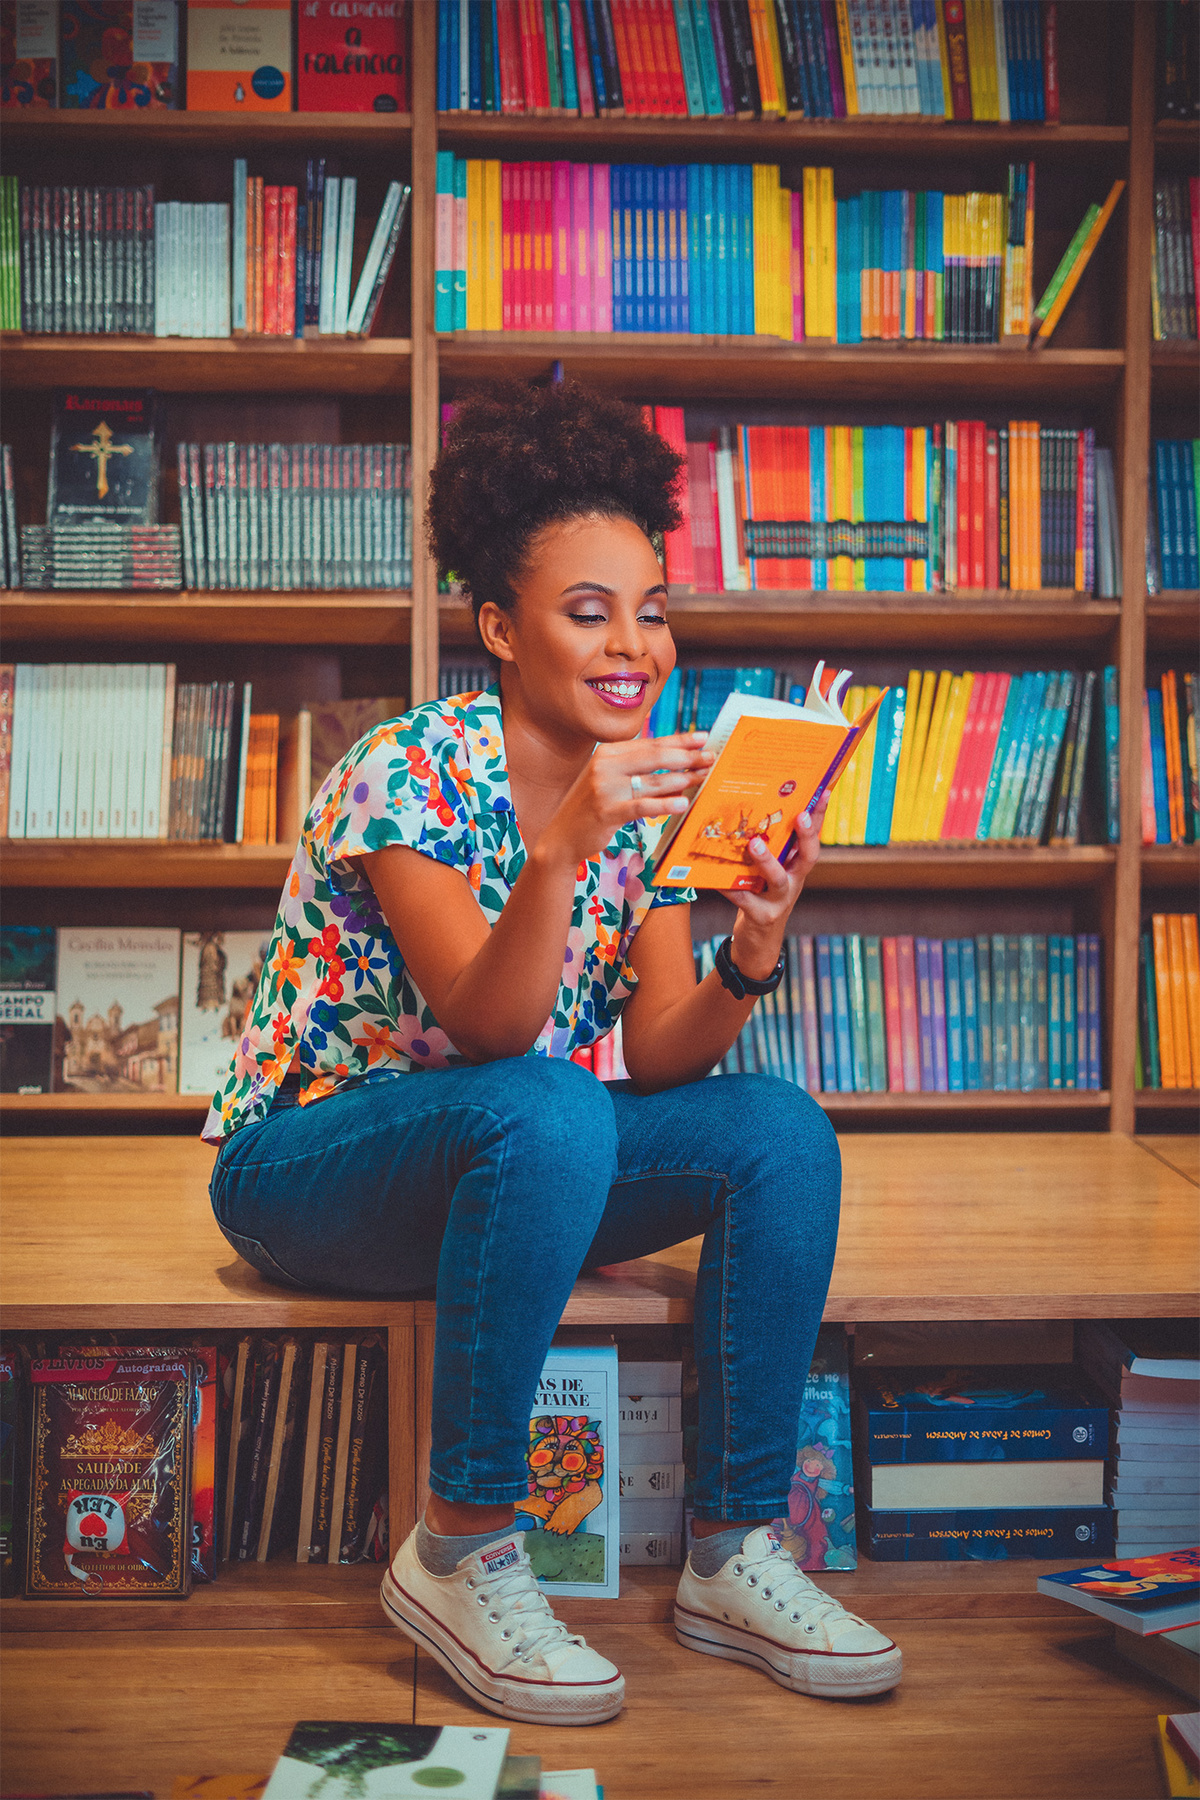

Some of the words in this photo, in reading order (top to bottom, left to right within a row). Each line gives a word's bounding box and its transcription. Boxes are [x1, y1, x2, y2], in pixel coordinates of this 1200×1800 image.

[116, 1363, 185, 1375] Autografado
[824, 1374, 840, 1383] no
[561, 1379, 583, 1391] DE
[67, 1387, 110, 1401] MARCELO
[112, 1387, 123, 1401] DE
[125, 1387, 157, 1401] FAZZIO
[926, 1431, 967, 1440] Andersen
[969, 1430, 980, 1439] de
[982, 1430, 1008, 1440] Fadas
[1010, 1430, 1021, 1439] de
[1022, 1430, 1051, 1440] Contos
[76, 1462, 142, 1474] SAUDADE
[60, 1479, 72, 1490] AS
[73, 1479, 114, 1491] PEGADAS
[115, 1479, 129, 1490] DA
[131, 1479, 157, 1491] ALMA
[72, 1497, 118, 1520] LER
[929, 1530, 970, 1540] Andersen
[972, 1529, 982, 1538] de
[984, 1529, 1010, 1539] Fadas
[1013, 1529, 1023, 1537] de
[1025, 1528, 1054, 1538] Contos
[485, 1544, 513, 1560] CONVERSE
[487, 1560, 500, 1574] ALL
[504, 1550, 519, 1566] STAR
